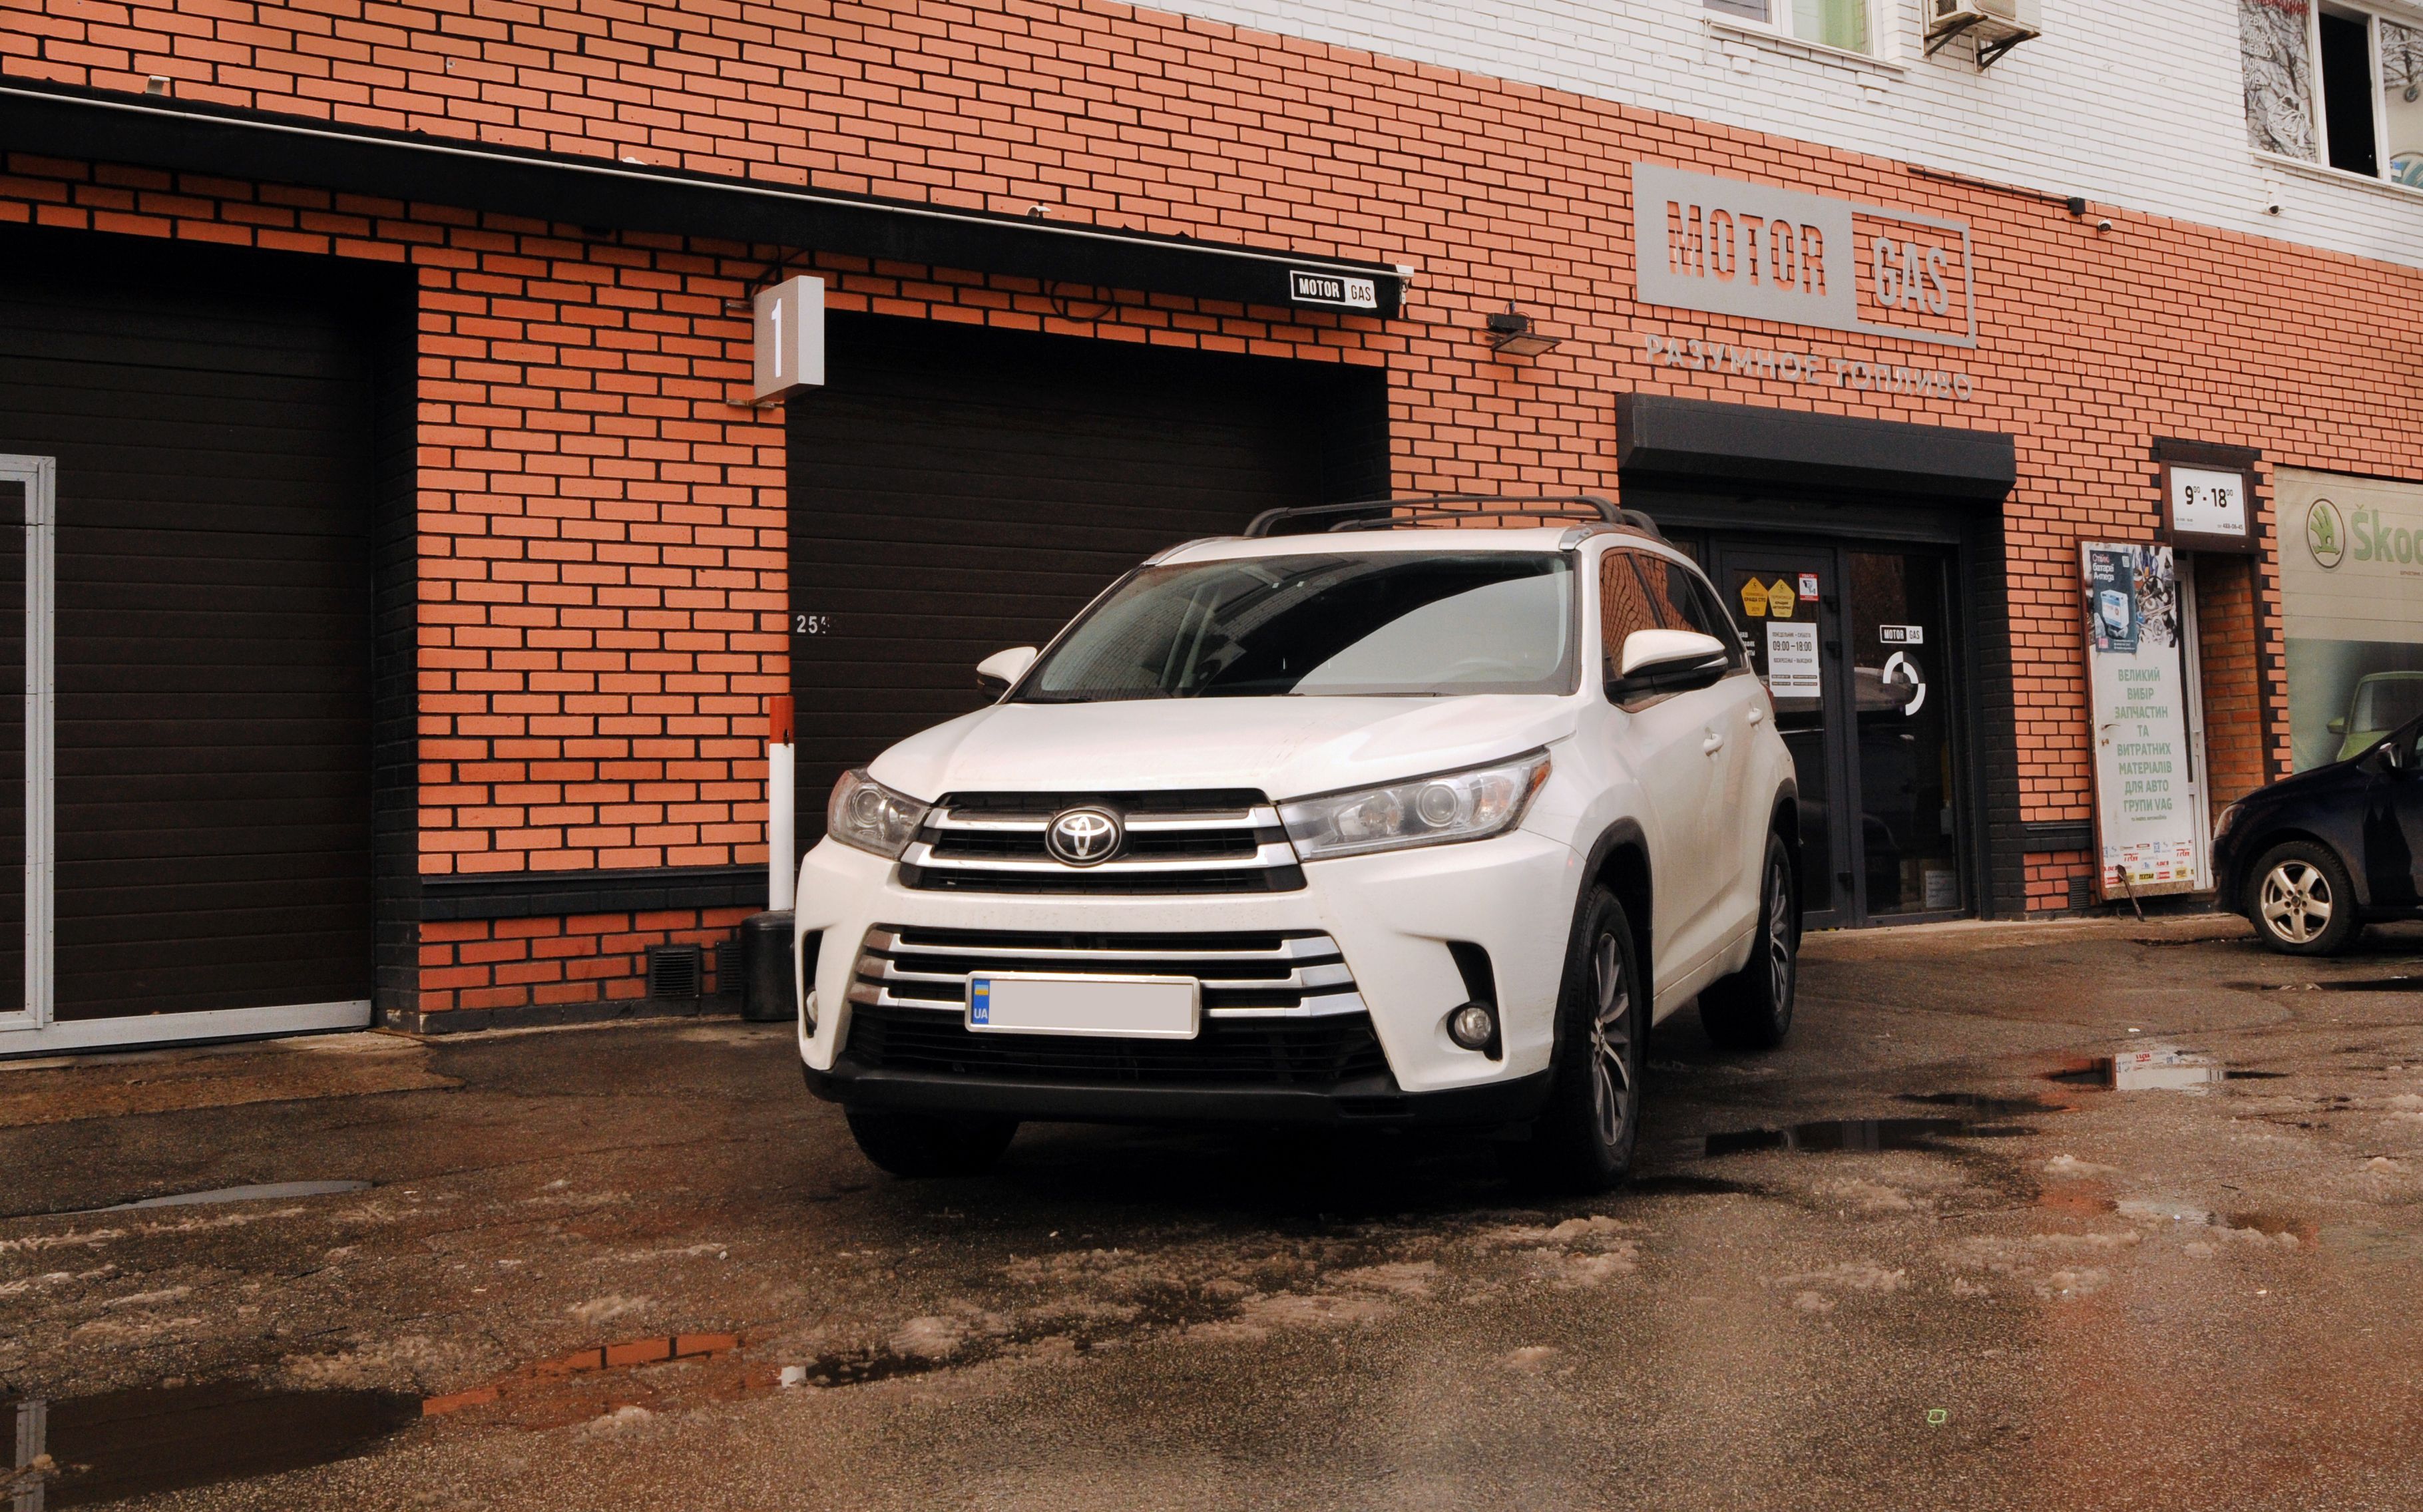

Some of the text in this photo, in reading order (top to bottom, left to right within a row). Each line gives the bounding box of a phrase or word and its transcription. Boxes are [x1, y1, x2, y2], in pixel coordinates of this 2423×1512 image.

[1667, 200, 1949, 316] MOTOR GAS
[1299, 278, 1371, 301] MOTOR GAS
[771, 297, 782, 378] 1
[1646, 334, 1972, 401] РАЗУМНОЕ ТОПЛИВО
[1884, 629, 1920, 640] MOTOR GAS
[1773, 640, 1790, 651] 09:00
[1796, 641, 1812, 652] 18:00
[2117, 666, 2160, 682] ВЕЛИКИЙ
[2127, 687, 2154, 701] ВИБІР
[2114, 705, 2169, 719] ЗАПЧАСТИН
[2137, 724, 2149, 737] ТА
[2117, 743, 2171, 757] ВИТРАТНИХ
[2119, 761, 2172, 775] МАТЕРІАЛІВ
[2124, 779, 2169, 796] ДЛЯ АВТО
[2123, 799, 2173, 813] ГРУПИ VAG
[974, 1008, 989, 1020] UA
